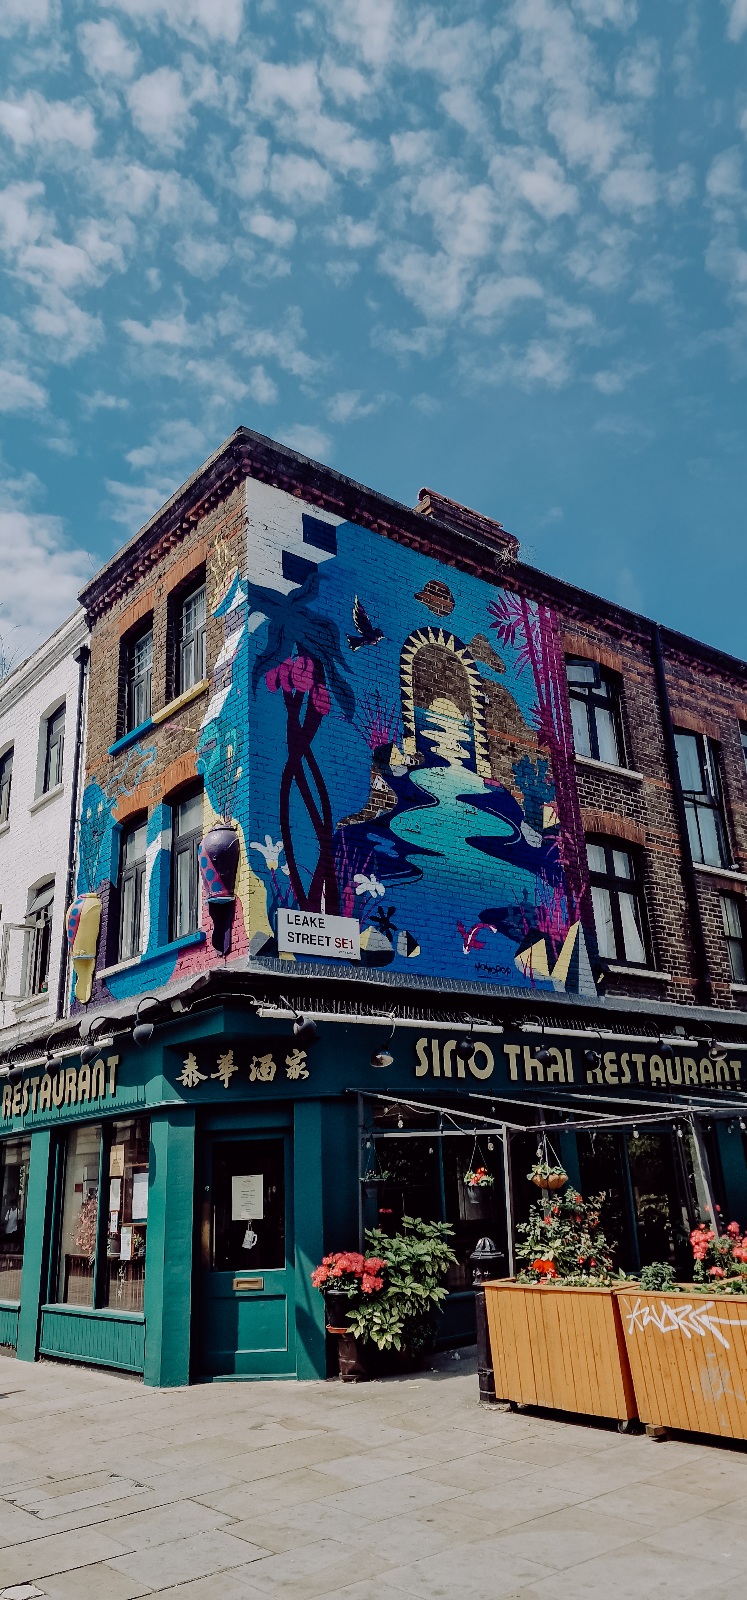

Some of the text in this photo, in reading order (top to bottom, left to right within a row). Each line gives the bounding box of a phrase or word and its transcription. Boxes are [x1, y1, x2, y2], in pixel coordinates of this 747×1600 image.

[287, 914, 326, 929] LEAKE
[287, 931, 354, 949] STREET SE1
[175, 1049, 310, 1088] 泰華酒家
[415, 1038, 495, 1080] SINO
[504, 1044, 575, 1083] THAI
[2, 1055, 119, 1119] RESTAURANT
